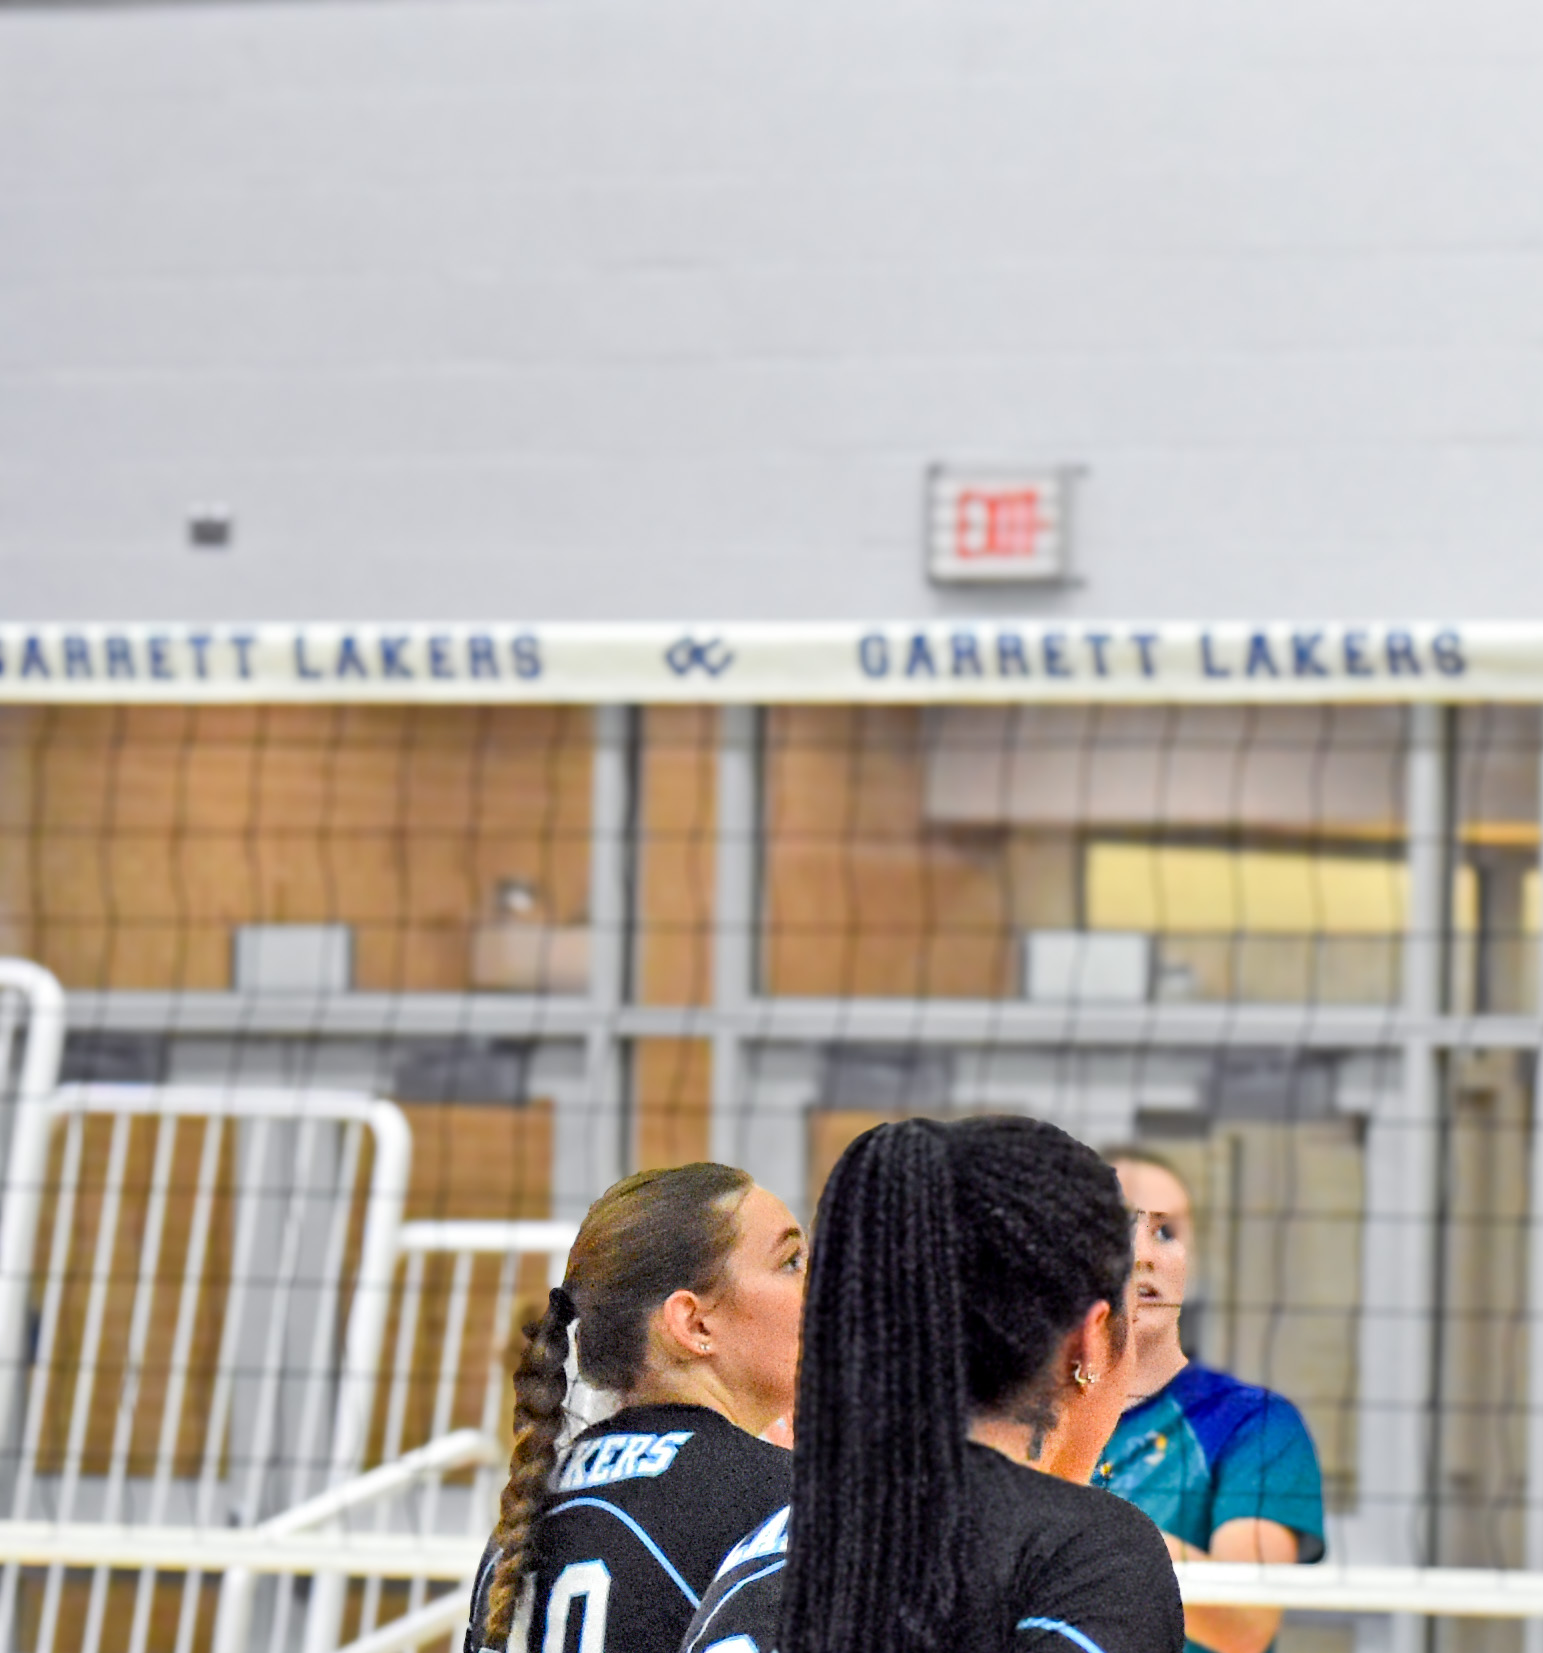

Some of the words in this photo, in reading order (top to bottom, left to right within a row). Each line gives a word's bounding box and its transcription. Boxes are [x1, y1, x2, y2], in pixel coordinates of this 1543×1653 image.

[0, 632, 253, 679] ARRETT
[293, 633, 542, 679] LAKERS
[859, 630, 1160, 679] GARRETT
[1200, 630, 1467, 678] LAKERS
[550, 1430, 695, 1493] KERS
